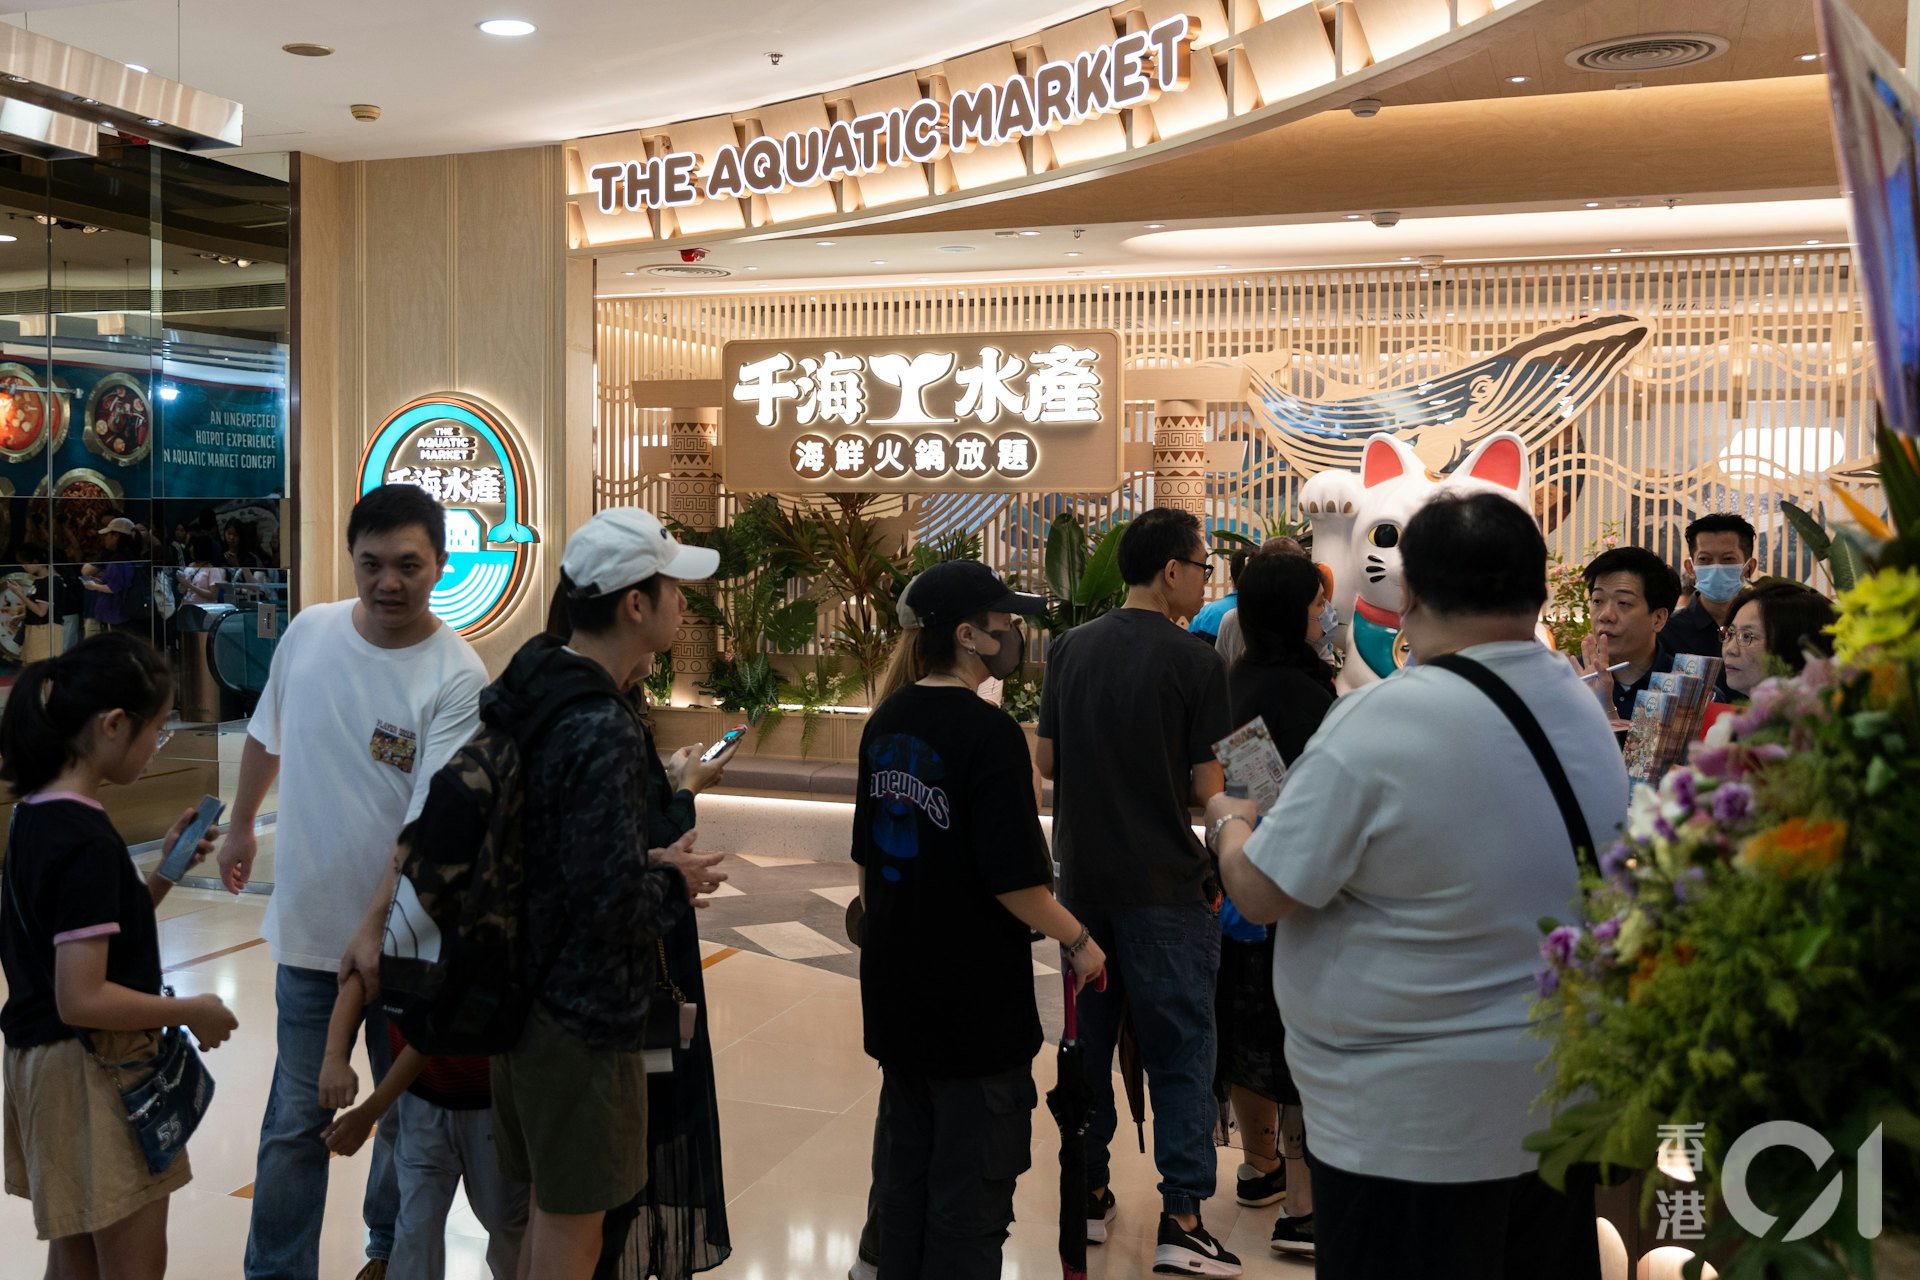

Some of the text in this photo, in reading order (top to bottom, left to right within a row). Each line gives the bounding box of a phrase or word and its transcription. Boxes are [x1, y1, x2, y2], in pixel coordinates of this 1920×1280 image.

[589, 13, 1190, 215] THE AQUATIC MARKET
[210, 411, 276, 428] AN UNEXPECTED
[196, 430, 275, 449] HOTPOT EXPERIENCE
[434, 427, 453, 436] THE
[417, 437, 470, 448] AQUATIC
[172, 449, 206, 467] AQUATIC
[207, 452, 239, 468] MARKET
[240, 454, 276, 469] CONCEPT
[420, 450, 469, 460] MARKET
[796, 439, 1030, 472] 海鮮火鍋放題
